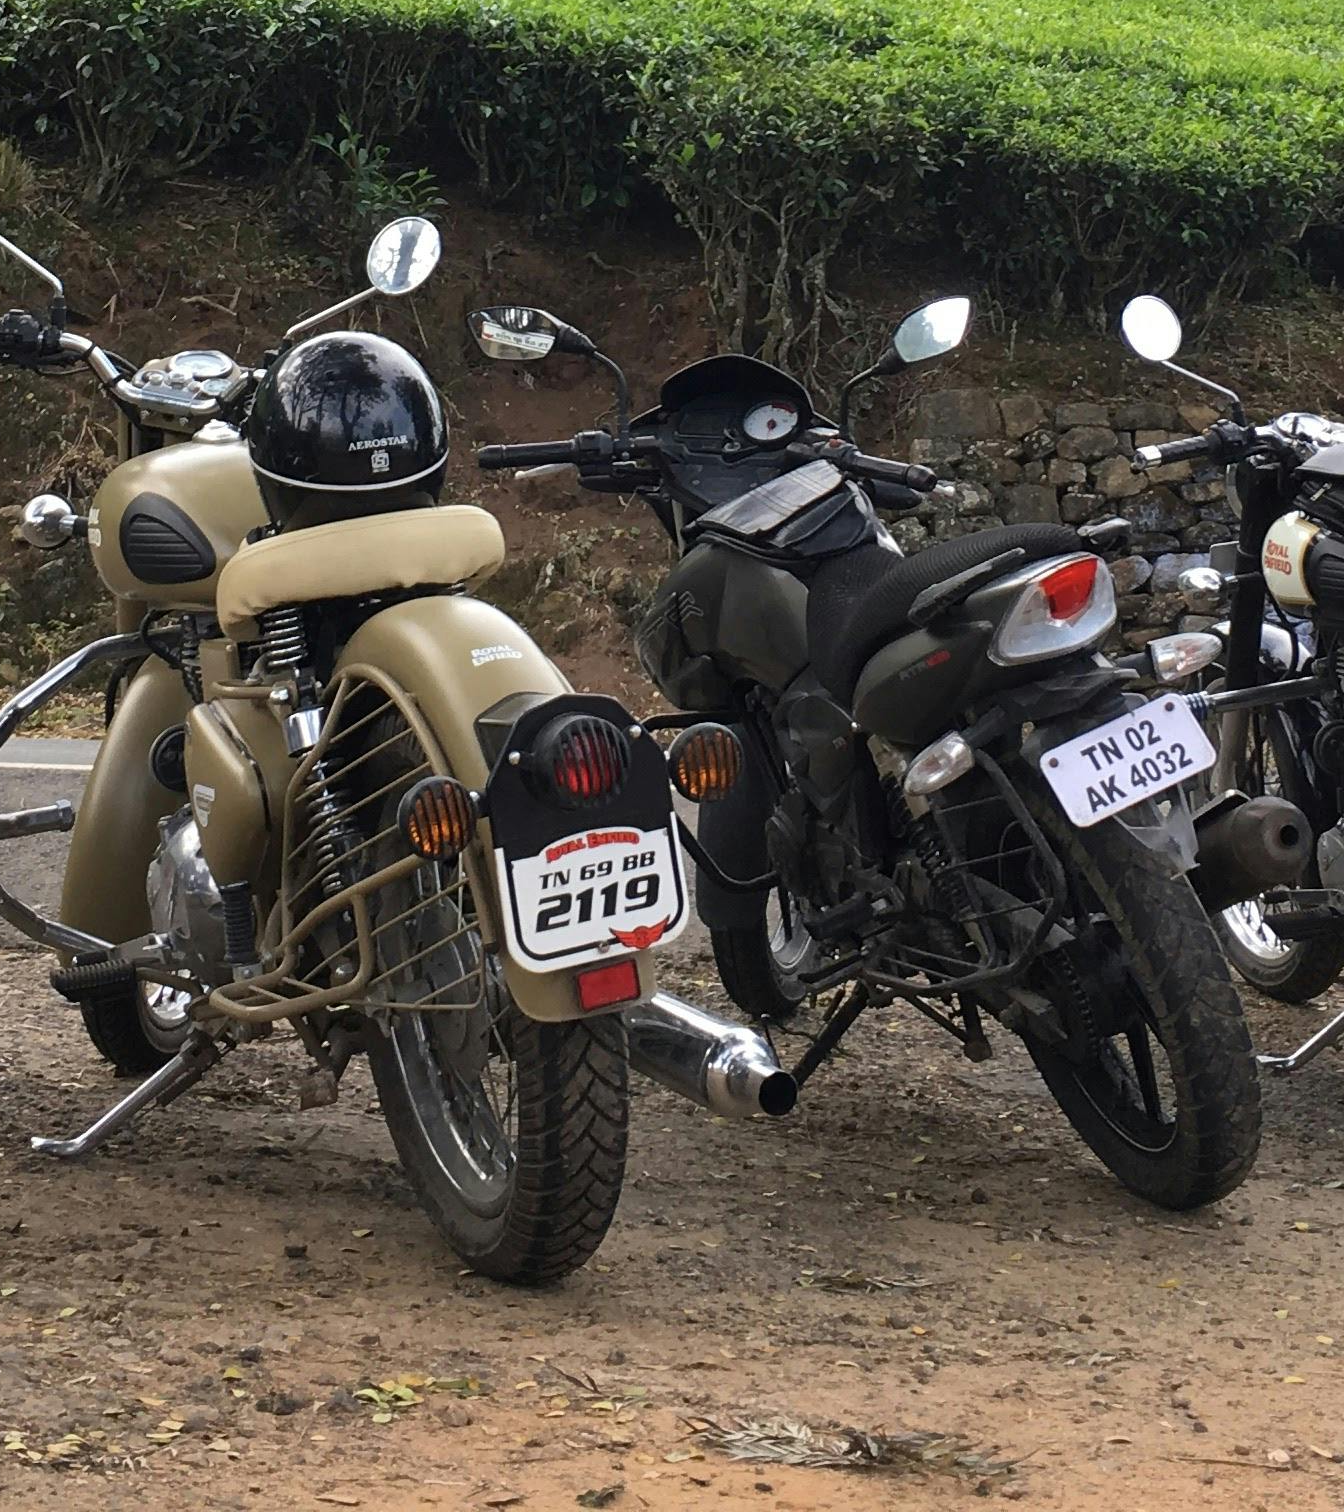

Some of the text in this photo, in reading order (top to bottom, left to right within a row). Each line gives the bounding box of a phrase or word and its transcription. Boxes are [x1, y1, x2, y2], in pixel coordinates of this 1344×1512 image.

[348, 434, 409, 452] AEROSTAR
[1266, 540, 1289, 558] ROYAL
[471, 644, 513, 659] ROYAL
[472, 651, 523, 667] ENFIELD
[1080, 719, 1163, 771] TN 02
[1086, 742, 1194, 813] AK 4032
[539, 850, 656, 890] TN 69 BB
[535, 872, 661, 934] 2119
